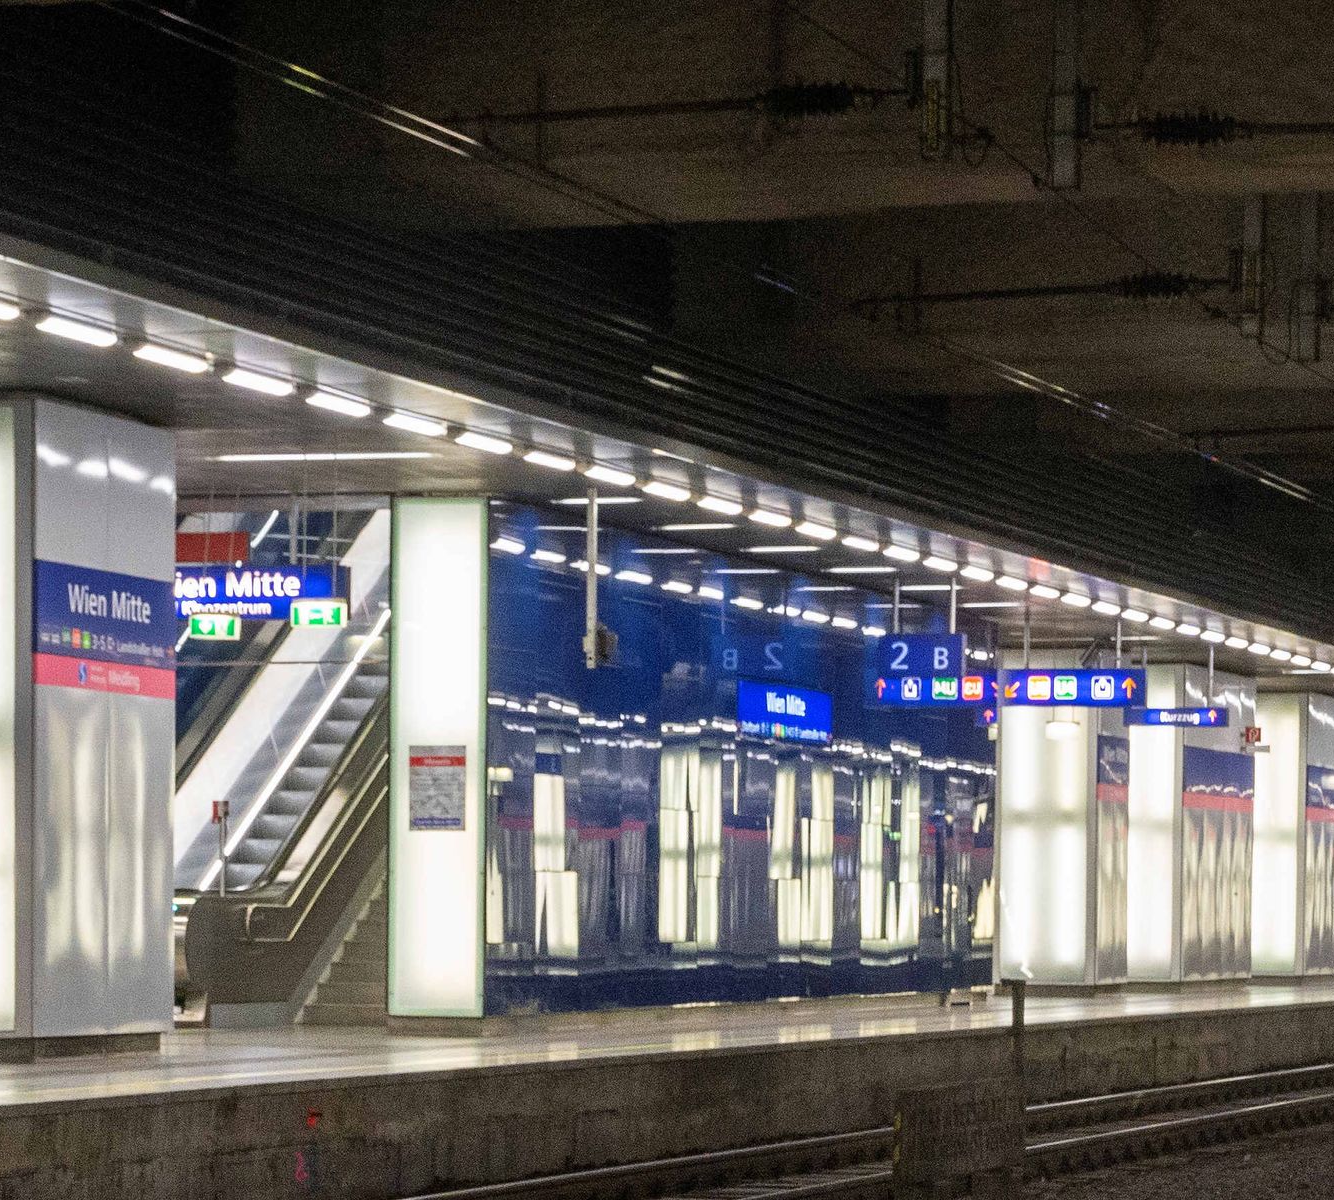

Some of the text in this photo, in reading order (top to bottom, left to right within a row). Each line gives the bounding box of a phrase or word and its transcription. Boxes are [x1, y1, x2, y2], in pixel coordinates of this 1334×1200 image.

[174, 571, 301, 599] ien Mitte
[67, 582, 151, 624] Wien Mitte
[890, 641, 948, 670] 2 B
[1159, 711, 1200, 724] Kurzzug
